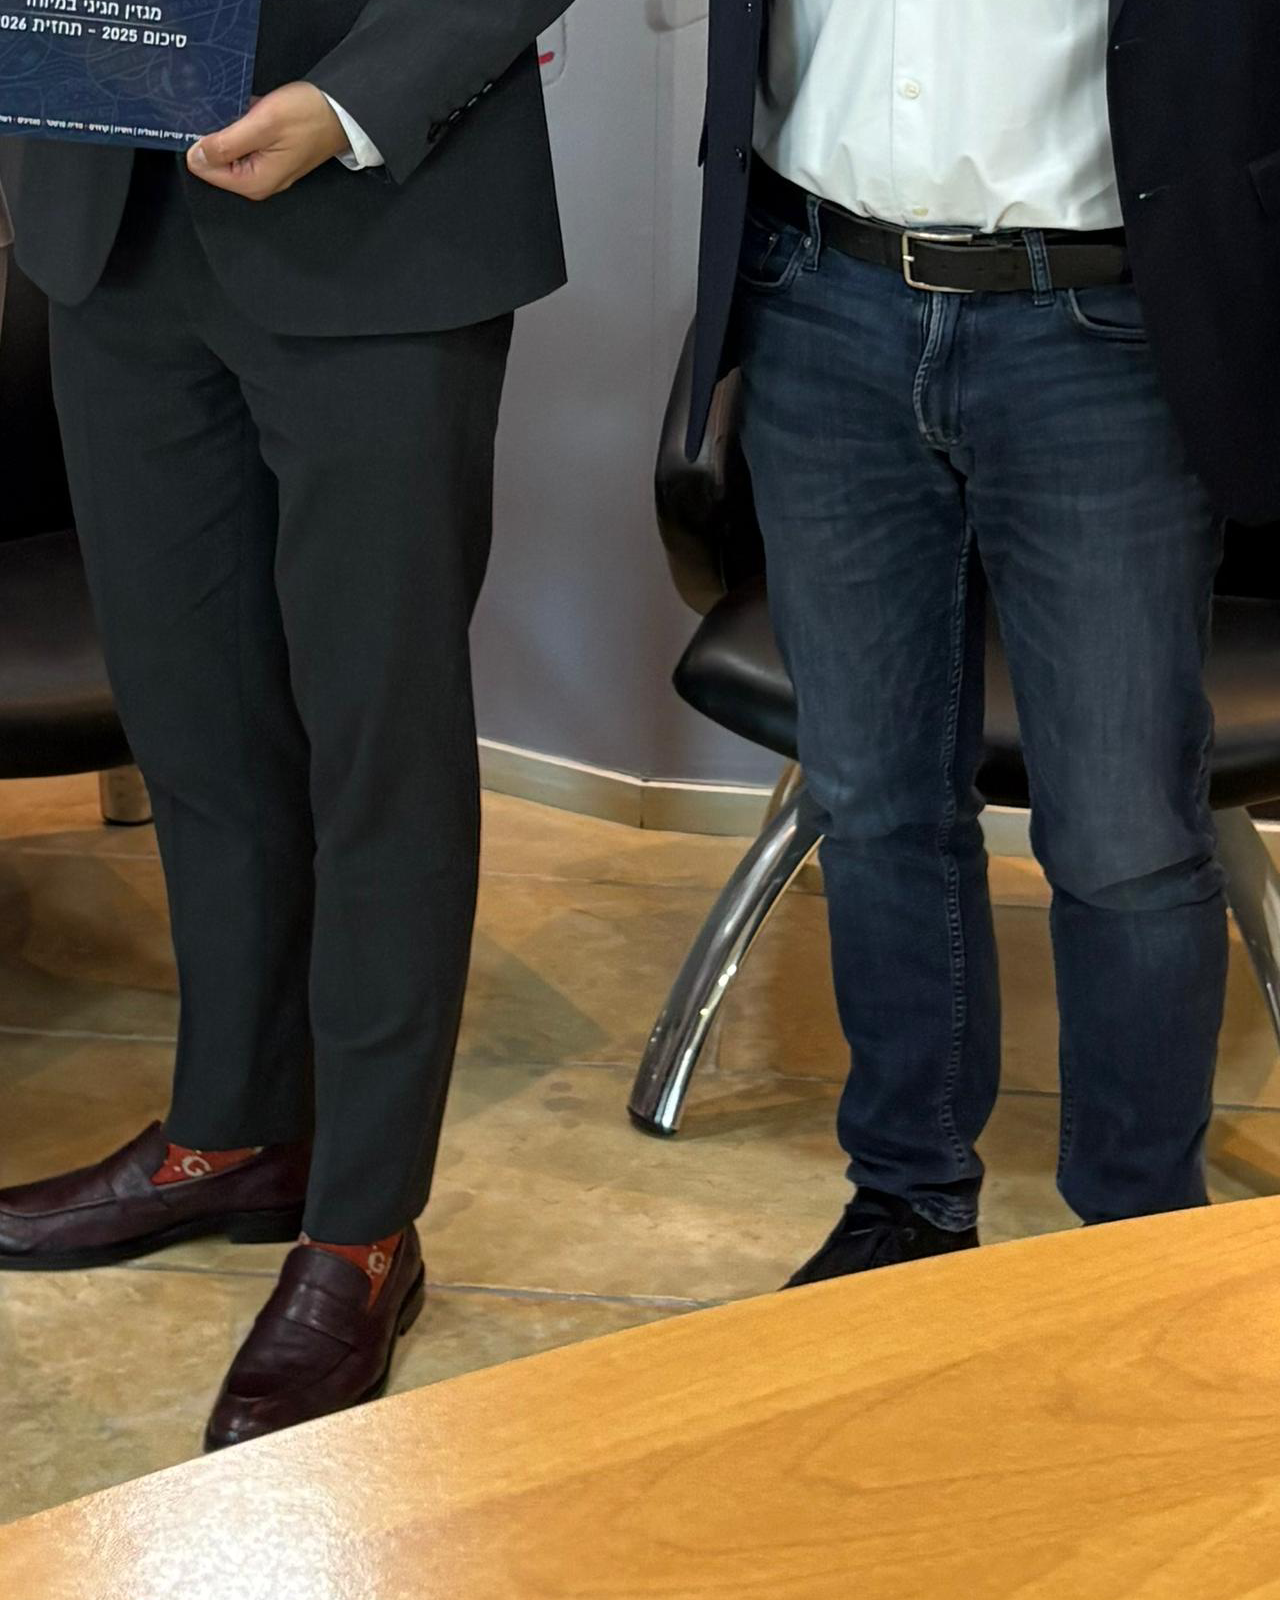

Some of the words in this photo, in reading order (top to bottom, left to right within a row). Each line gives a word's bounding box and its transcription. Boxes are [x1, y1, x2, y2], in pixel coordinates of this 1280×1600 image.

[124, 3, 163, 21] מגזין
[32, 17, 82, 36] תחזית
[102, 26, 138, 42] 2025
[143, 31, 187, 48] סיכום
